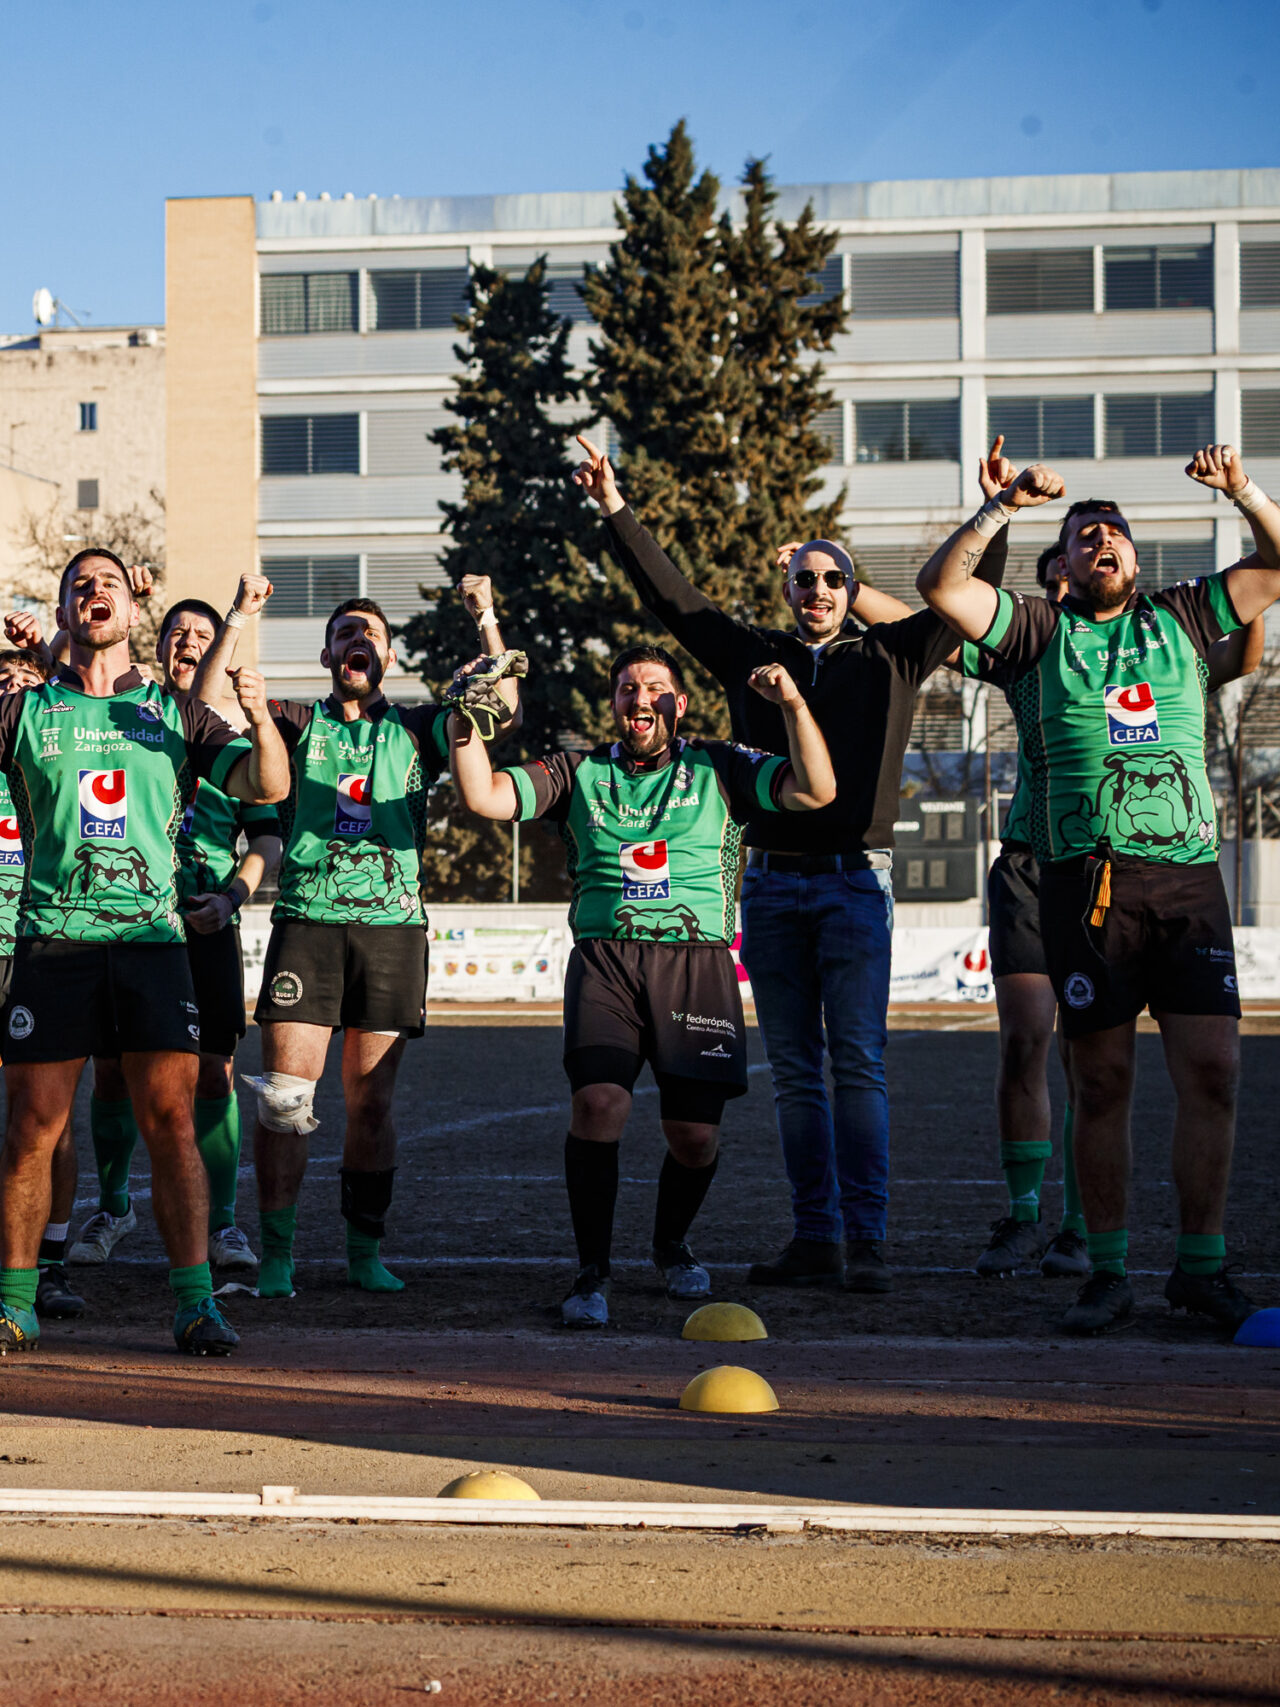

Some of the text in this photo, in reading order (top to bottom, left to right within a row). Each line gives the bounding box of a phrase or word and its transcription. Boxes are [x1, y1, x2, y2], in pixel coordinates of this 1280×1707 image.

[73, 727, 165, 743] Universidad
[1113, 727, 1156, 743] CEFA
[74, 740, 133, 755] Zaragoza
[84, 821, 123, 837] CEFA
[626, 884, 667, 899] CEFA
